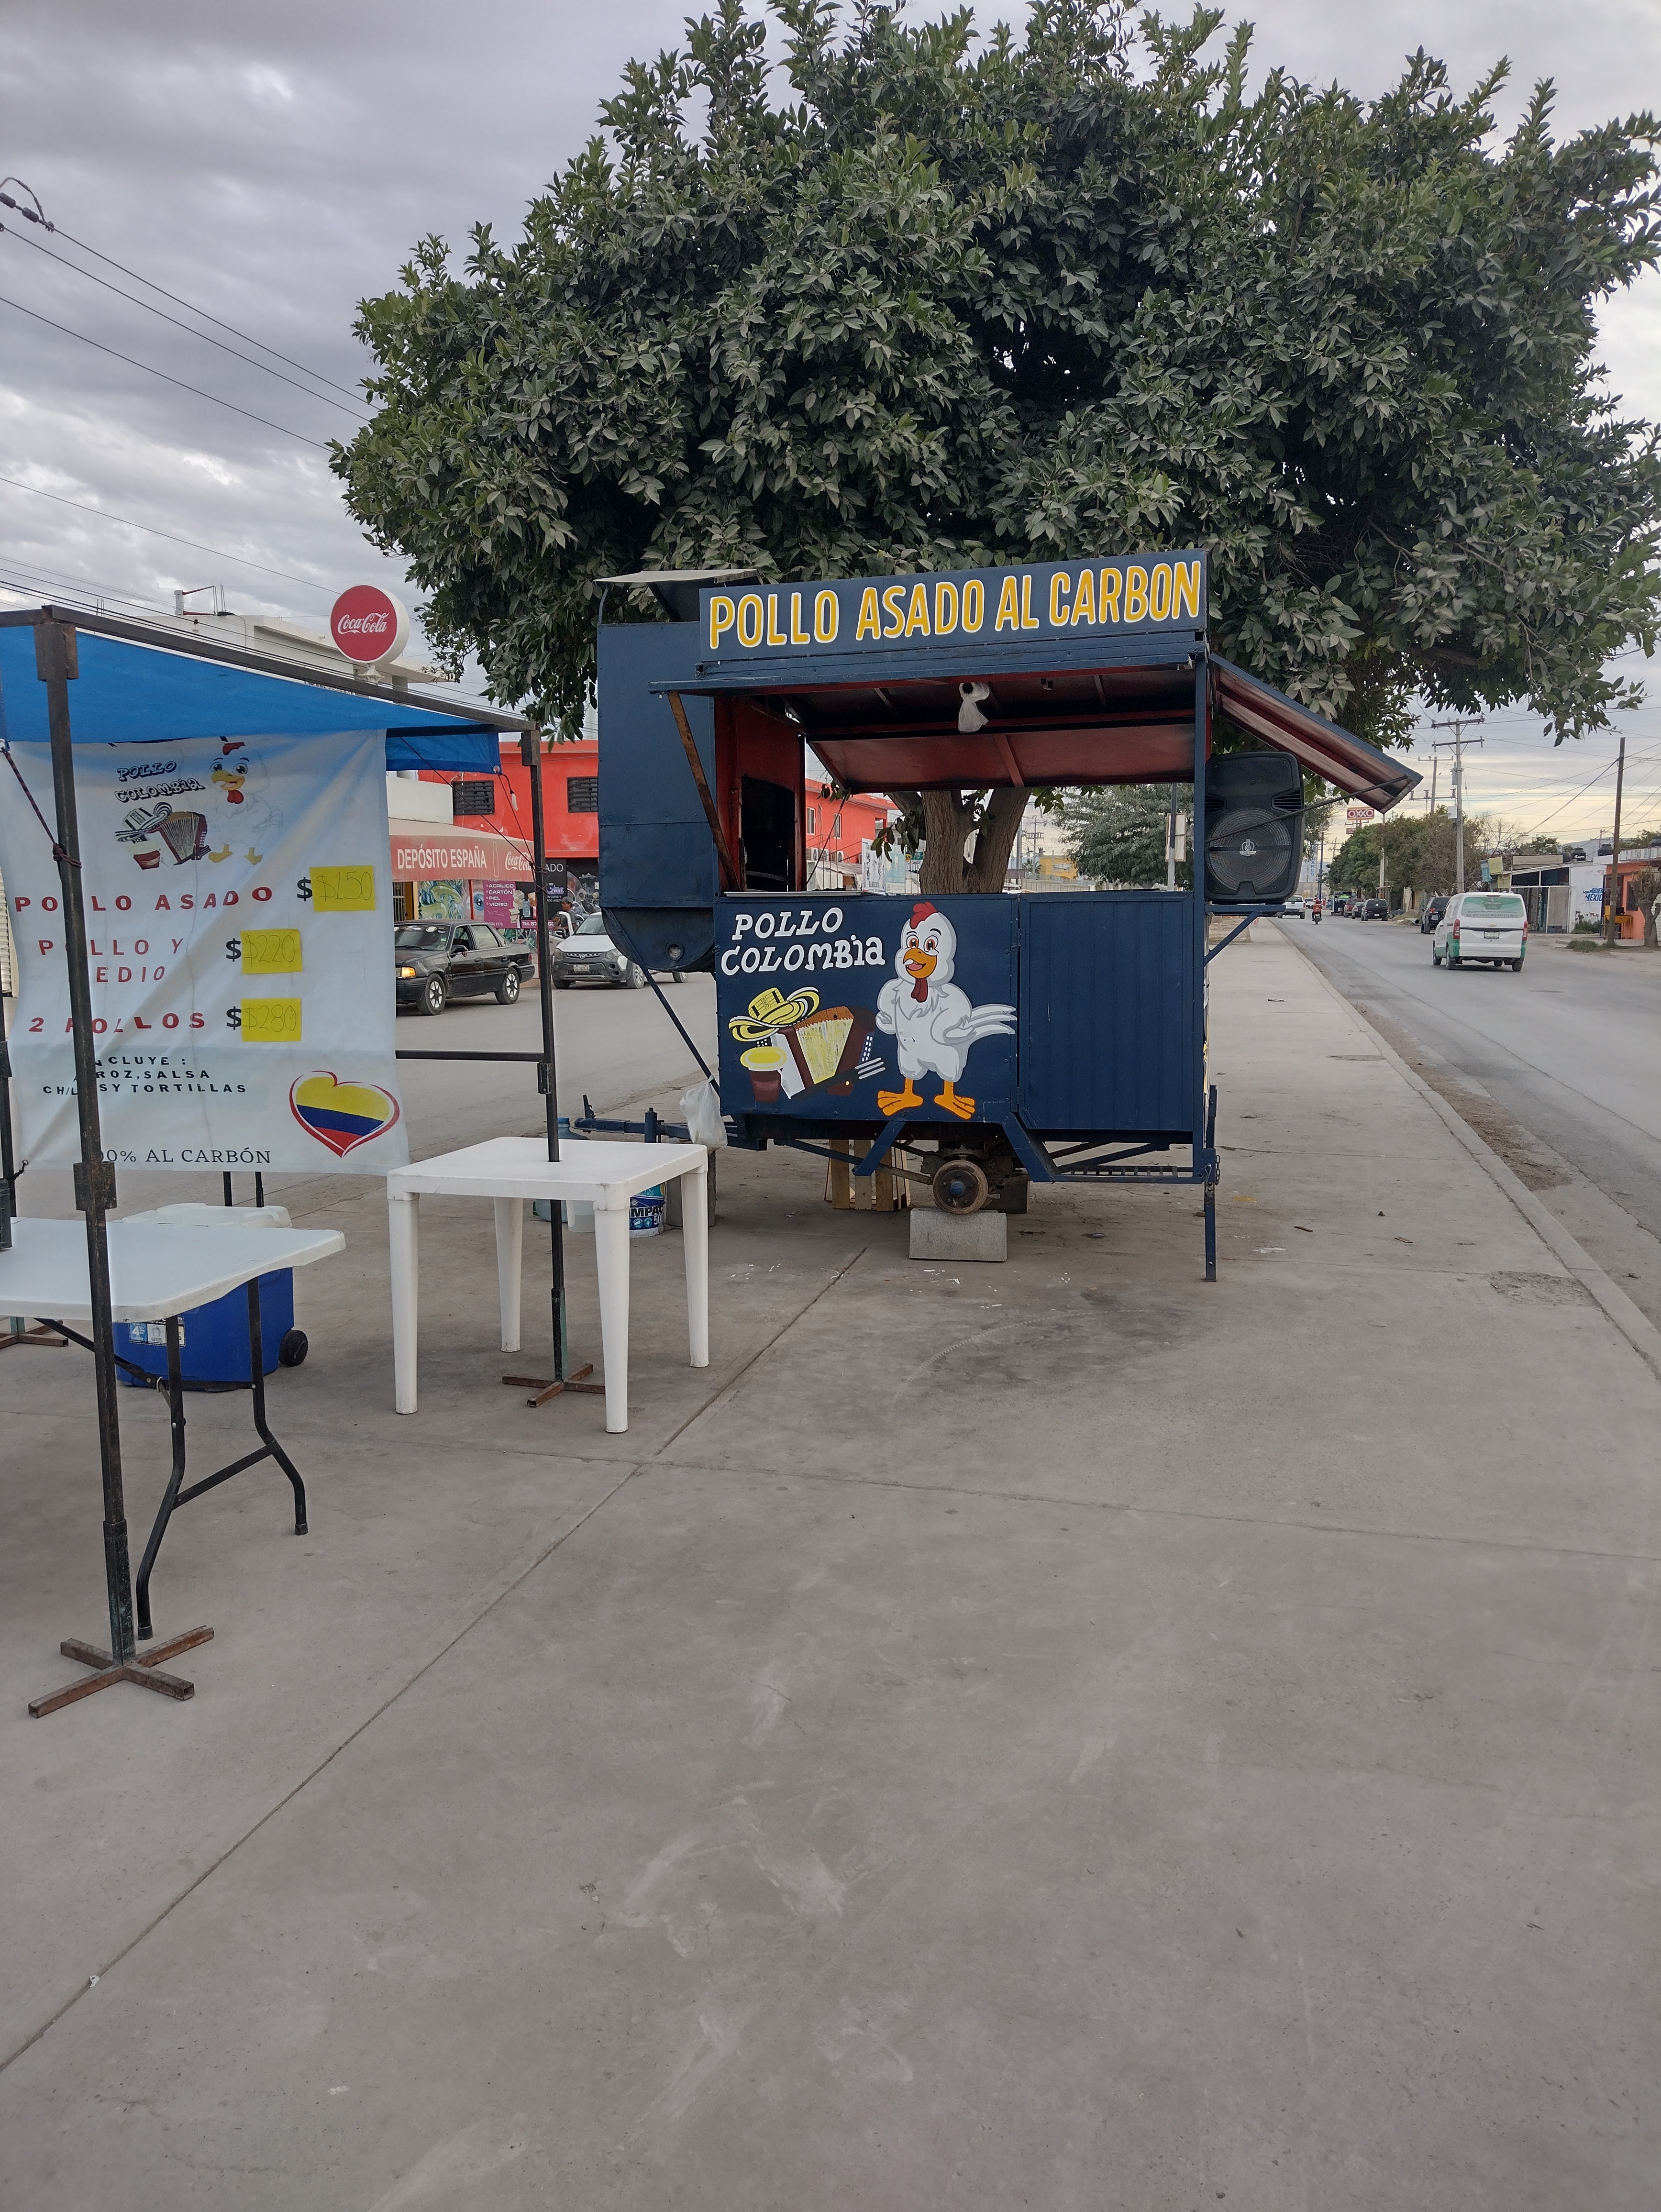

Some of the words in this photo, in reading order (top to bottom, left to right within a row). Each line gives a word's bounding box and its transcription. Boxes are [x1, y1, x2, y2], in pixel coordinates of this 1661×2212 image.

[709, 589, 839, 649] POLLO
[855, 579, 985, 641] ASADO
[995, 574, 1040, 631] AL
[1049, 560, 1201, 627] CARBON
[337, 612, 389, 634] Coca-Cola
[117, 761, 177, 782] POLLO
[1348, 809, 1374, 818] OXXO
[397, 844, 448, 869] DEPÓSITO
[450, 845, 487, 869] ESPAÑA
[316, 871, 372, 902] $150
[15, 896, 132, 912] POLO
[155, 886, 272, 910] ASADO
[731, 907, 843, 940] POLLO
[39, 939, 149, 956] PLLO
[171, 938, 184, 955] Y
[244, 934, 295, 967] $220
[97, 966, 165, 983] EDIO
[29, 1017, 44, 1032] 2
[243, 1004, 297, 1032] $280
[132, 1084, 246, 1093] TORTILLAS
[101, 1149, 136, 1162] 0%
[145, 1149, 174, 1162] AL
[181, 1147, 271, 1163] CARBÓN
